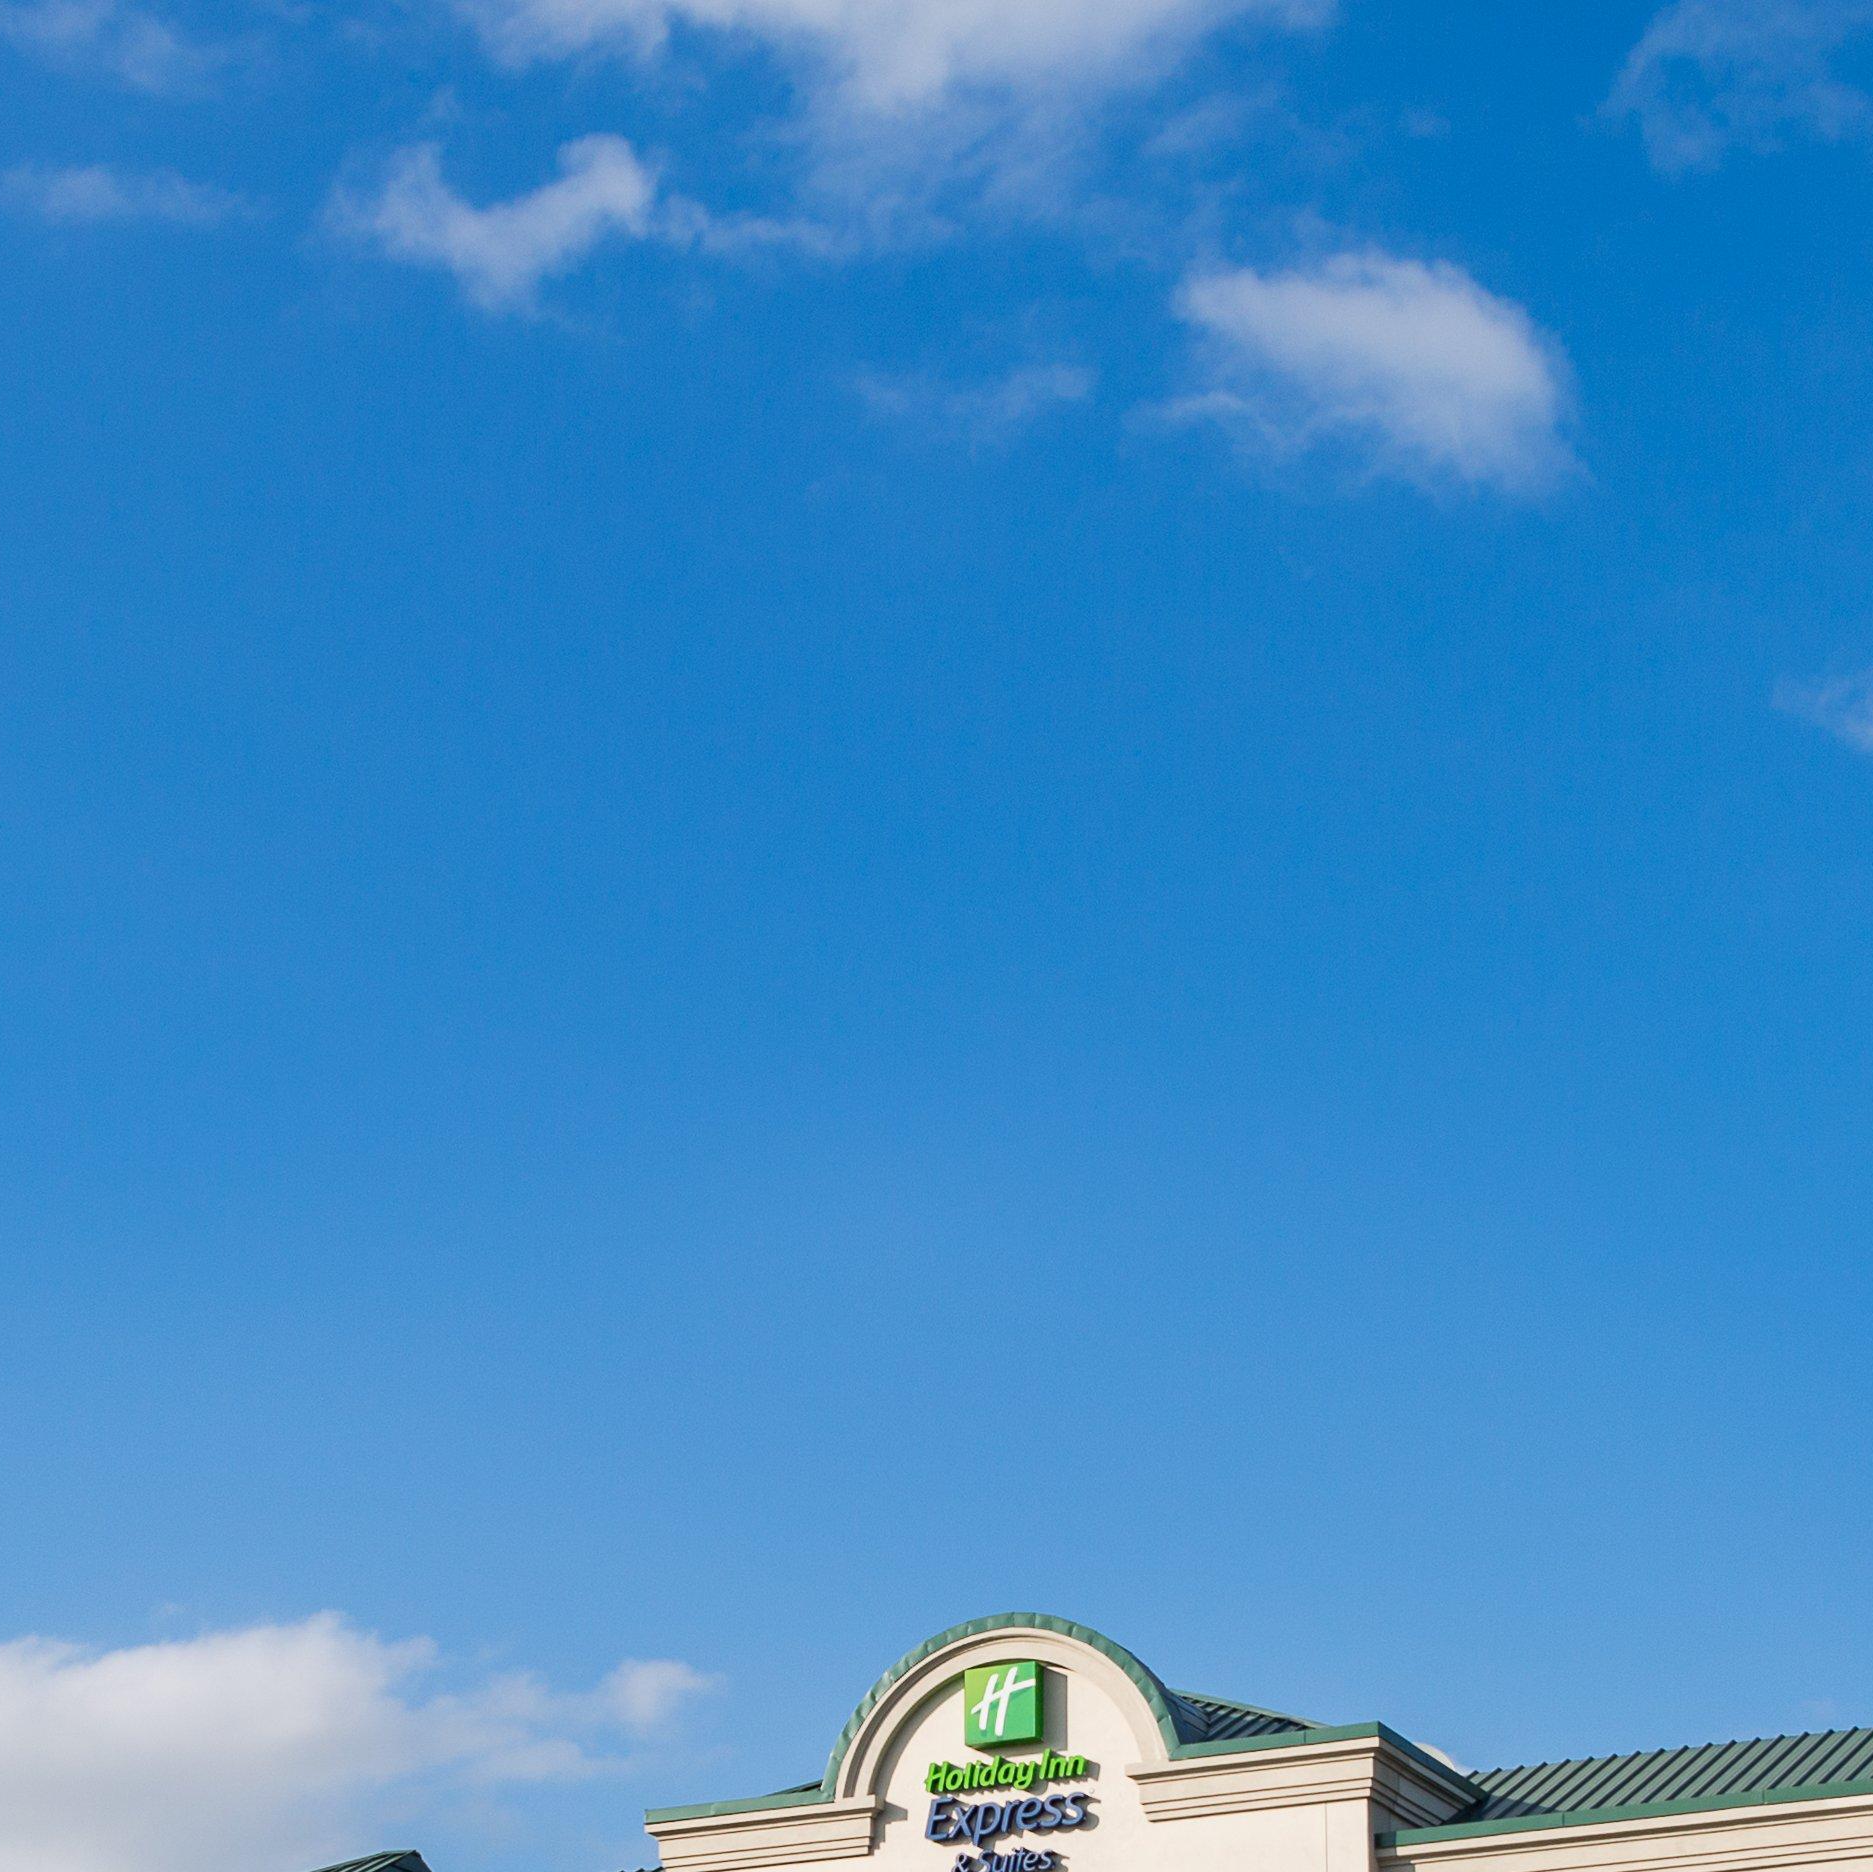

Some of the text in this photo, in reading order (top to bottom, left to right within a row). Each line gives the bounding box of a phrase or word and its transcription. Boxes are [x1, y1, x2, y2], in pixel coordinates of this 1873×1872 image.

[925, 1749, 1085, 1792] Holiday Inn
[925, 1791, 1086, 1847] Express
